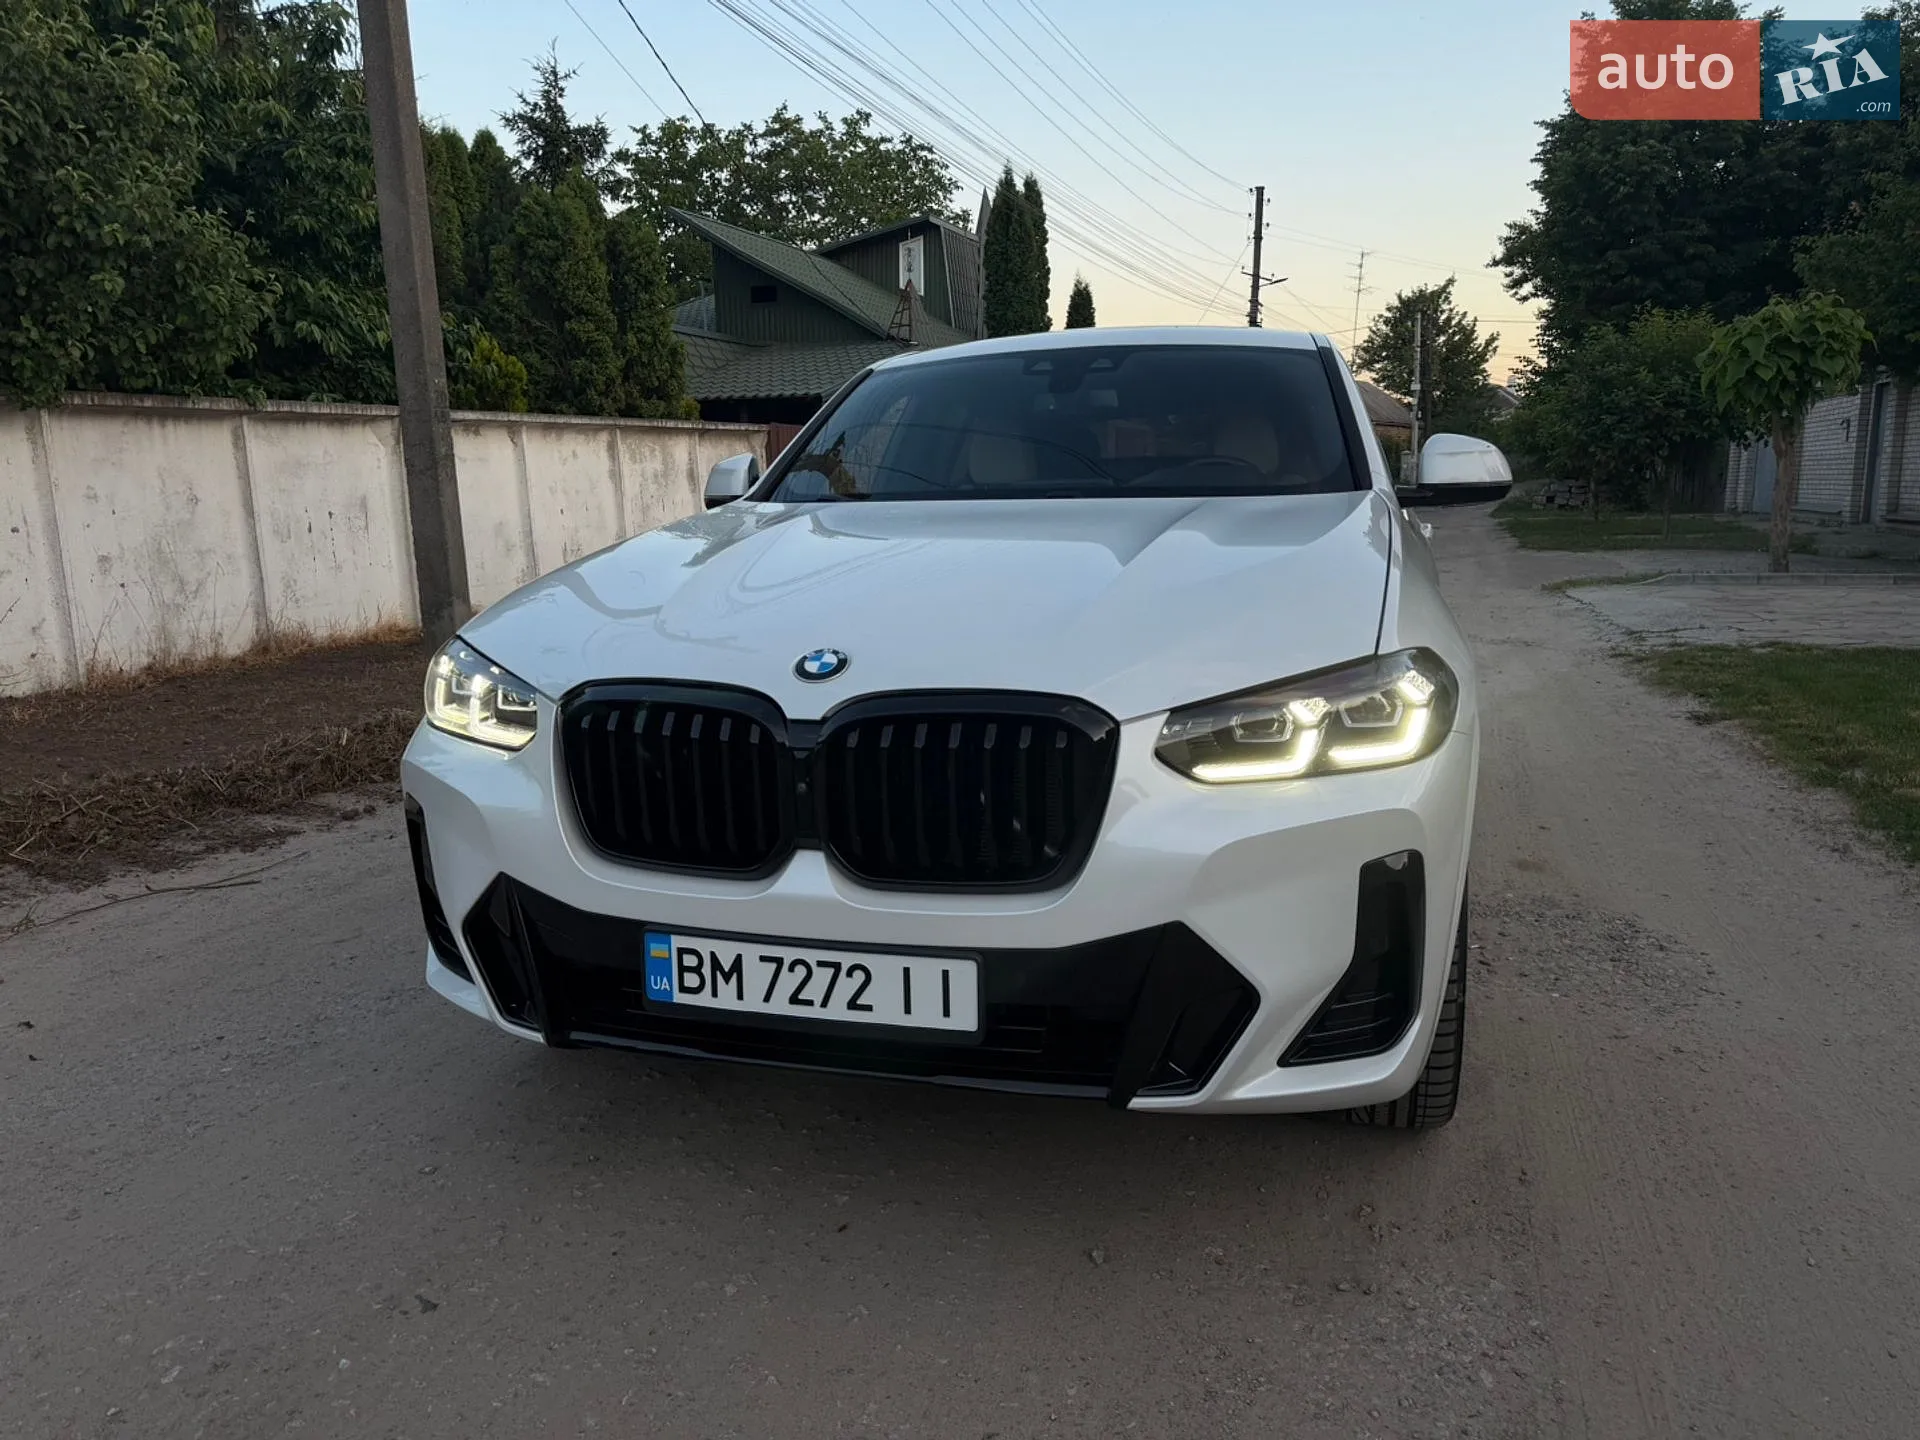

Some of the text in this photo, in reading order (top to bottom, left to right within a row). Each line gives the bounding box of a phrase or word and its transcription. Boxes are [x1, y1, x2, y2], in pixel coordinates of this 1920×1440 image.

[650, 975, 671, 992] UA
[676, 946, 744, 1001] BM
[759, 955, 873, 1012] 7272
